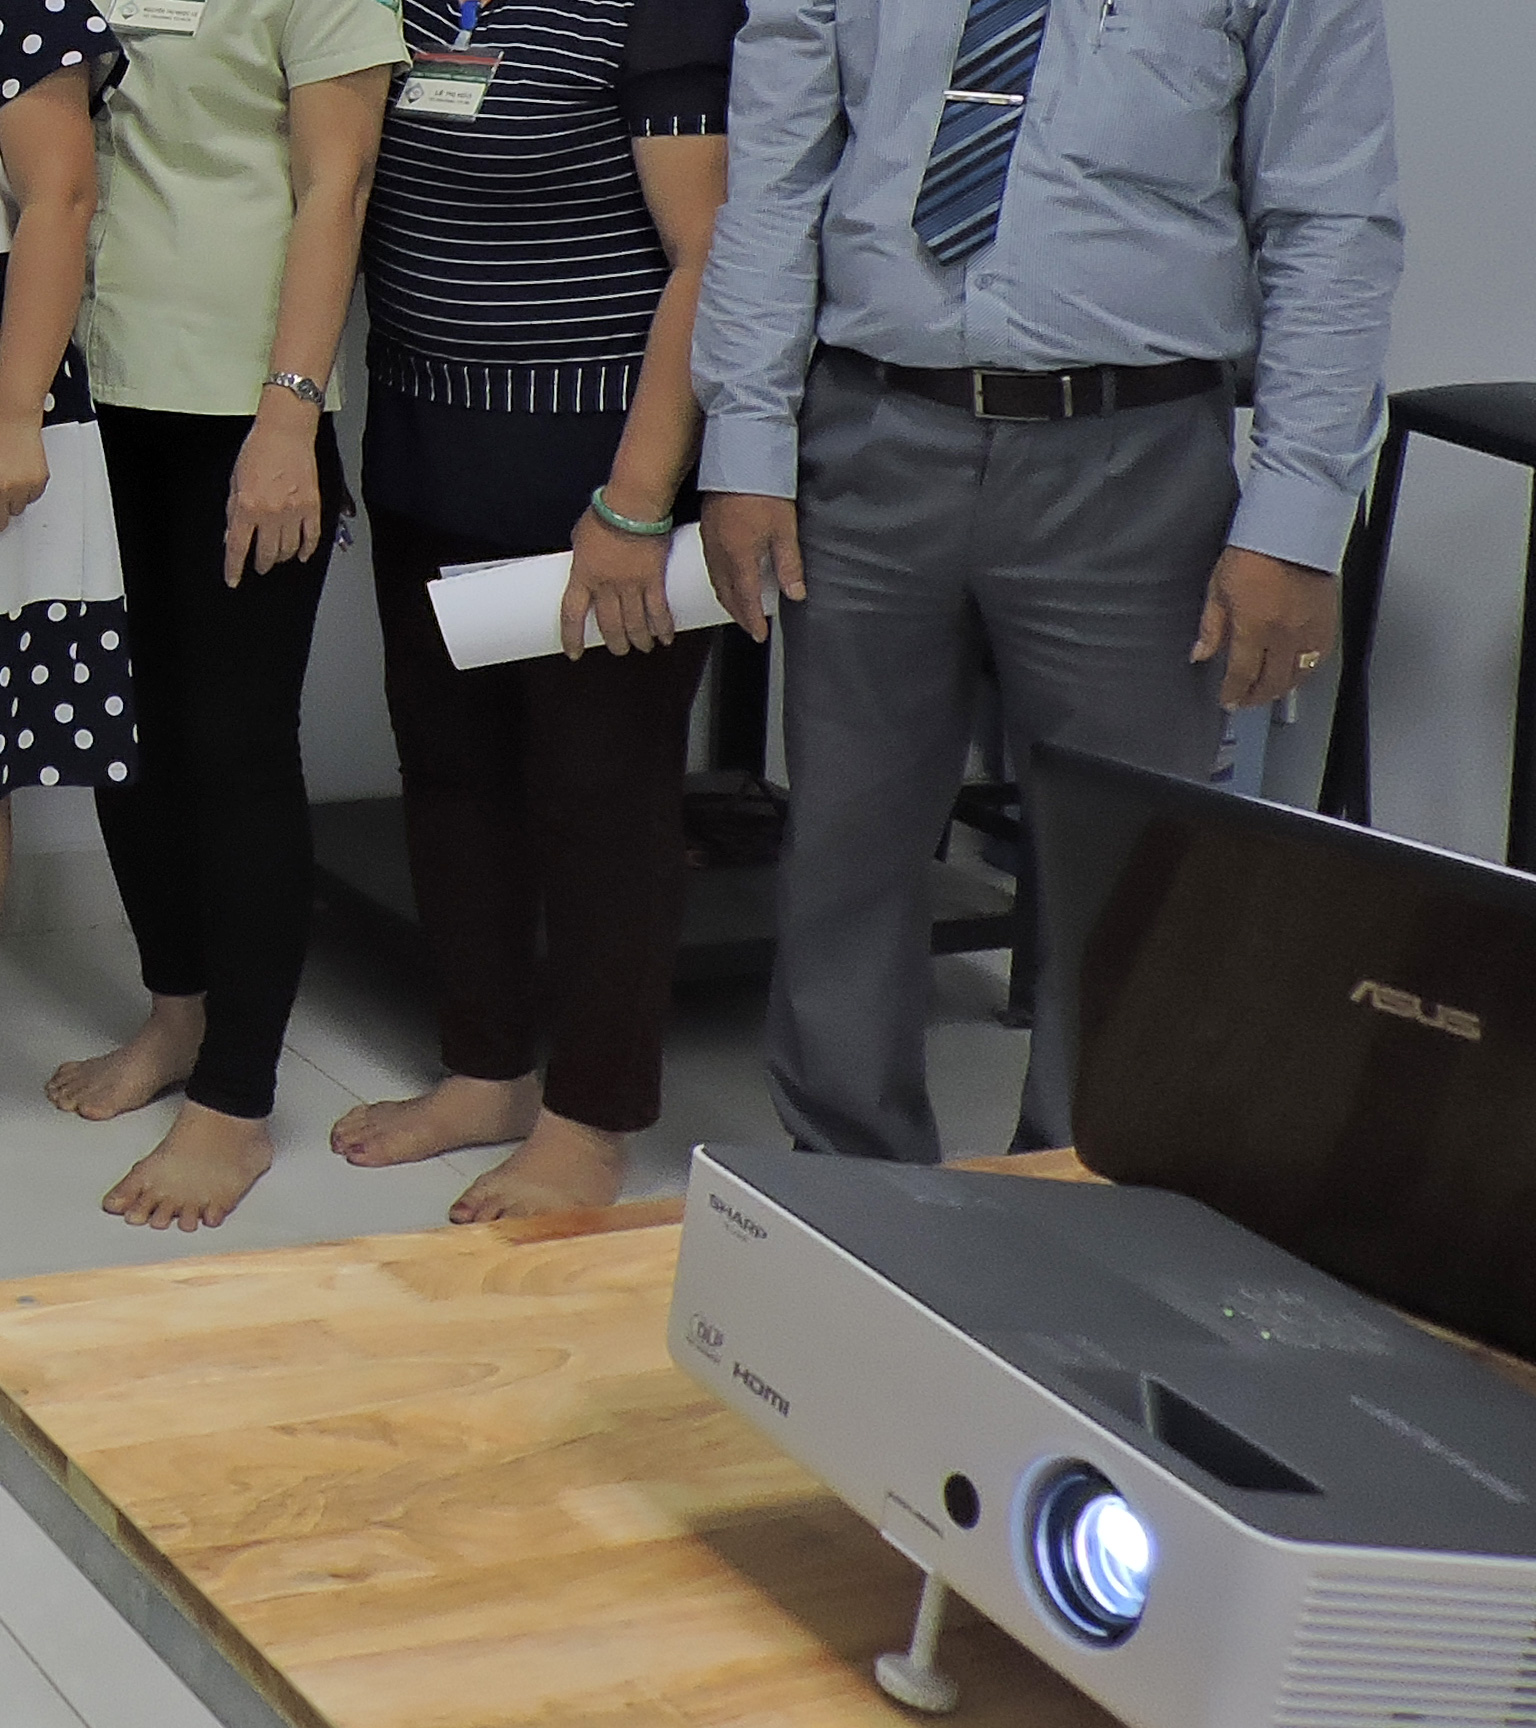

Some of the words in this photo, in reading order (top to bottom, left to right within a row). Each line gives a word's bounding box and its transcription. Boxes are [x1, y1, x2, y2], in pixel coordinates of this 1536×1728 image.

[1349, 980, 1483, 1043] ASUS
[708, 1193, 769, 1240] SHARP
[732, 1361, 791, 1419] HDMI
